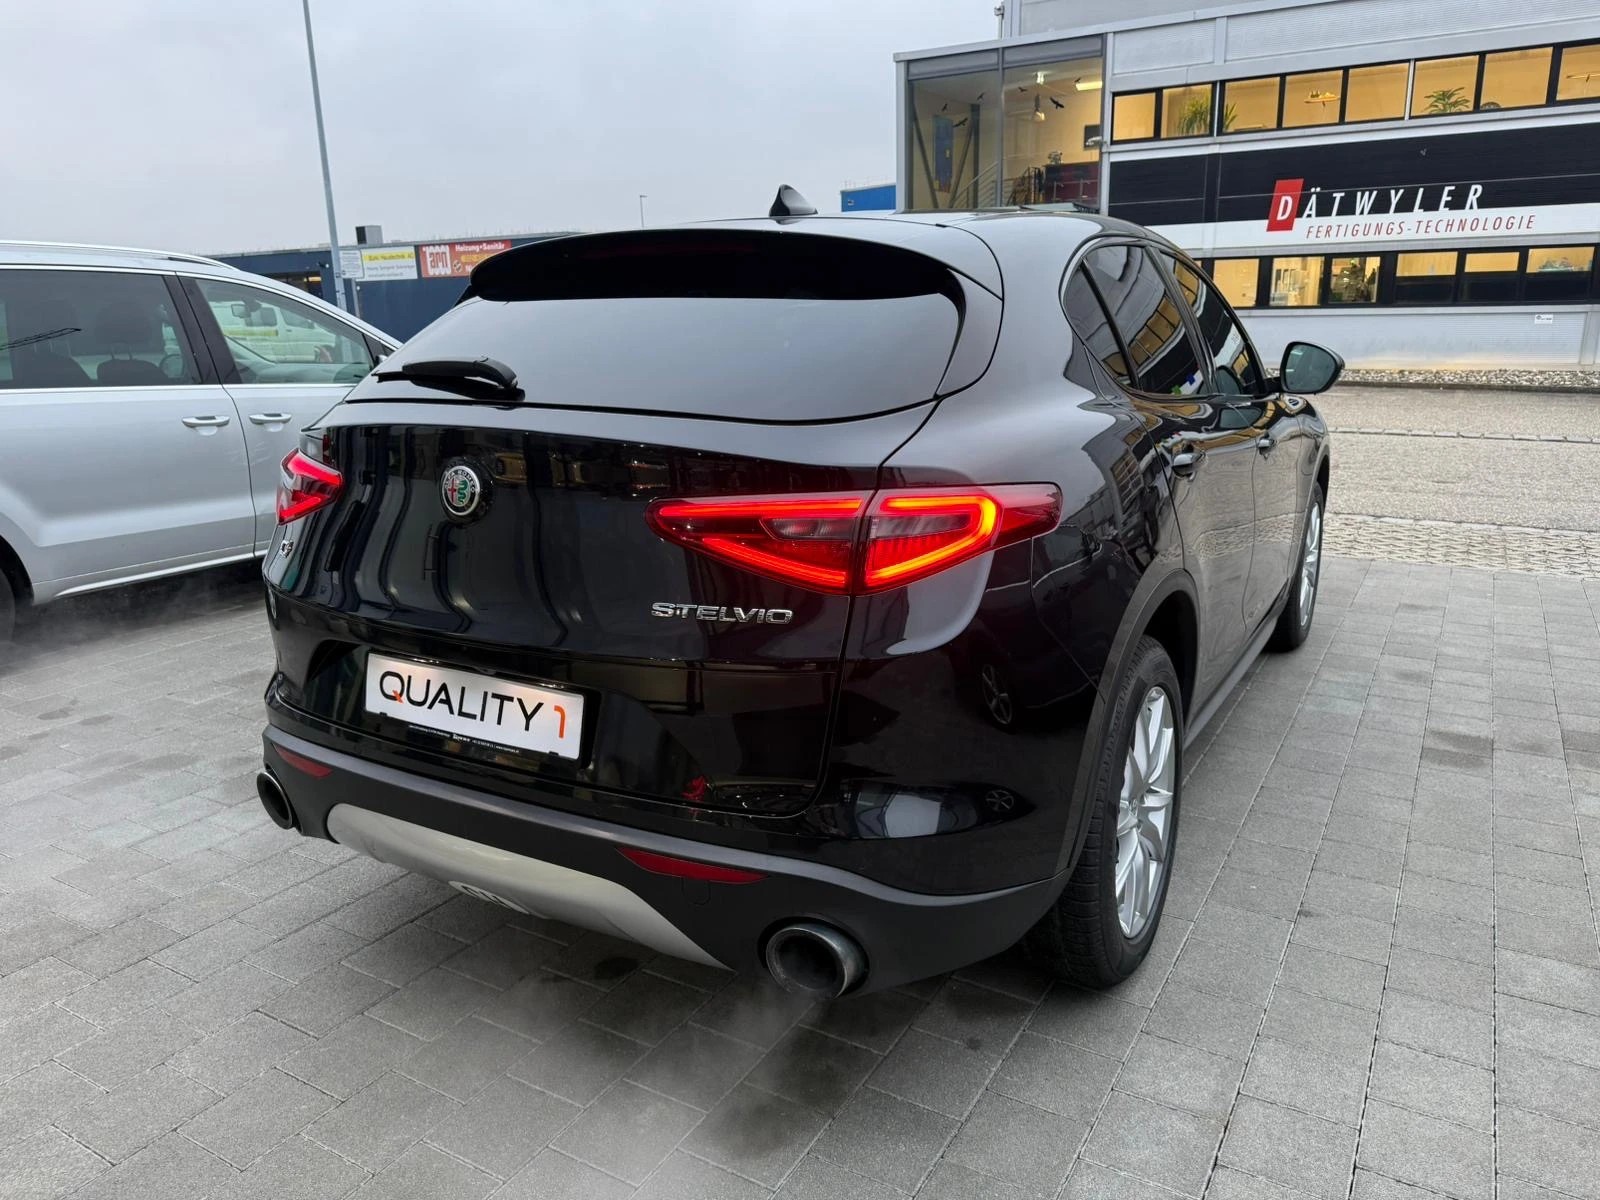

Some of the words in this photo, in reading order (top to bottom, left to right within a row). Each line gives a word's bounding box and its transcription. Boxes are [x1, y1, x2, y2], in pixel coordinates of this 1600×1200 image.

[1276, 184, 1483, 221] DÄTWYLER
[1306, 215, 1536, 239] FERTIGUNGS-TECHNOLOGIE
[651, 602, 794, 625] STELVIO
[379, 670, 544, 732] QUALITY
